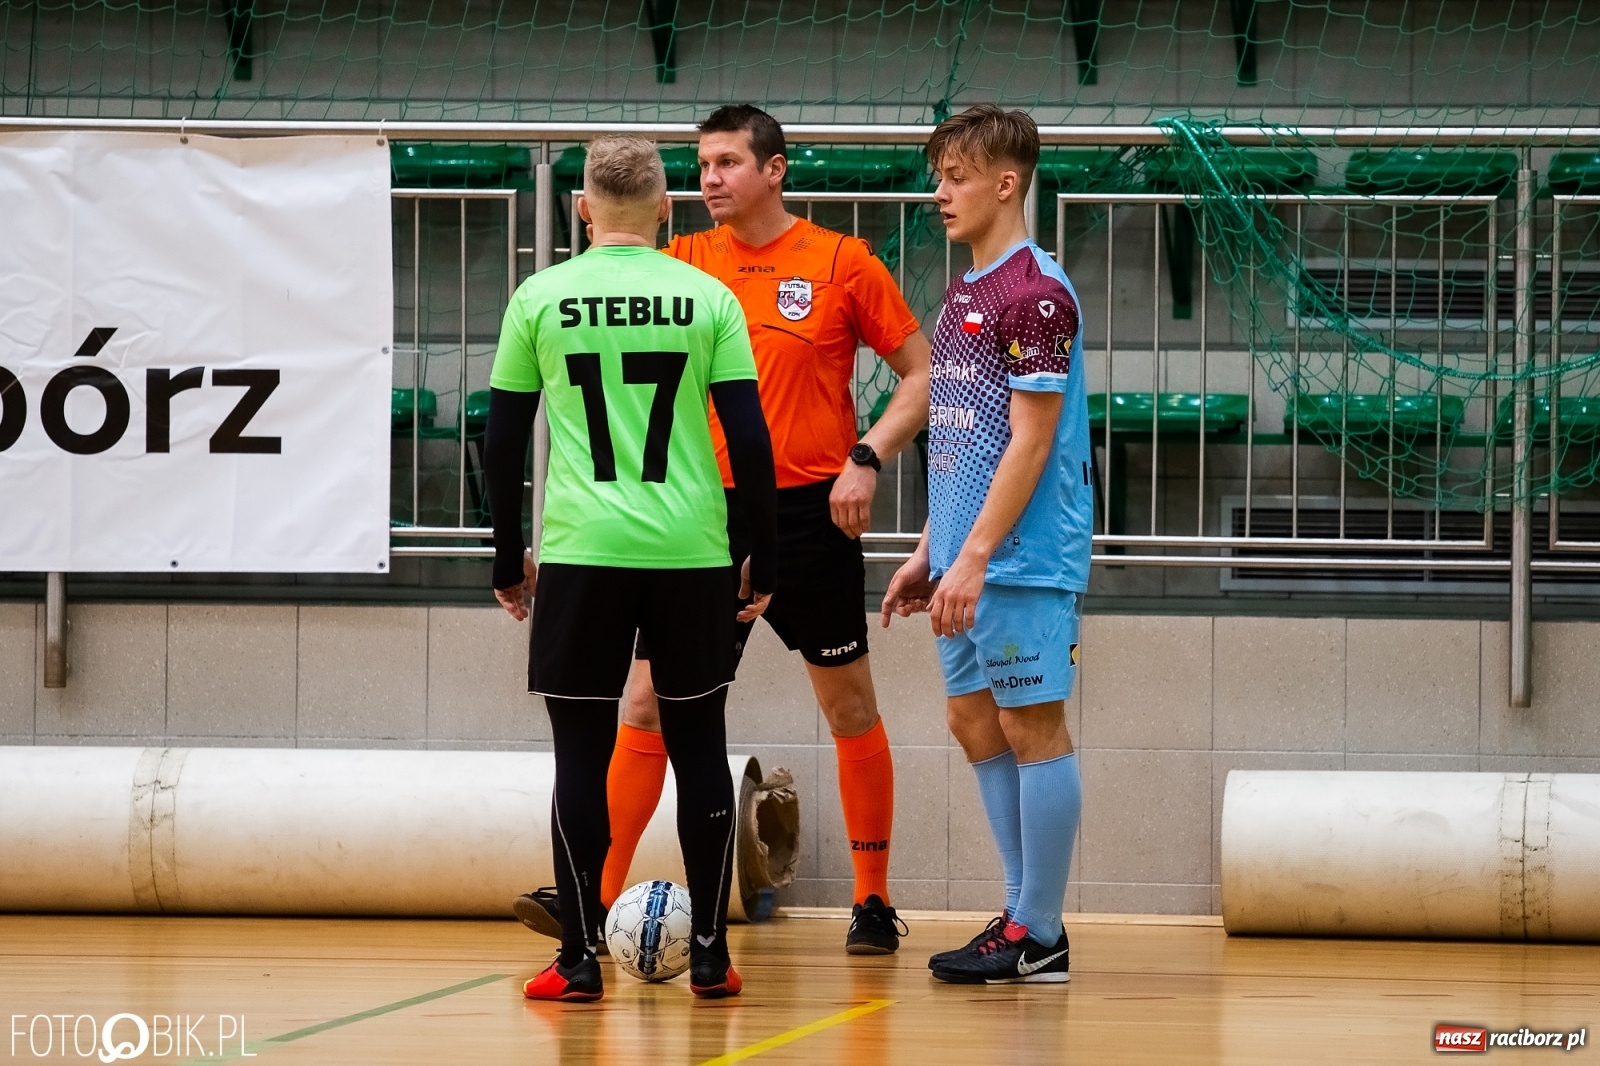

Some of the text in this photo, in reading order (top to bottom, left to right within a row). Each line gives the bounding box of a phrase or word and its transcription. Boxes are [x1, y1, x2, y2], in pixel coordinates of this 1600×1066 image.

[559, 296, 693, 328] STEBLU
[565, 351, 689, 483] 17
[821, 641, 857, 656] zina
[991, 675, 1043, 689] Int-Drew
[851, 840, 888, 851] zina
